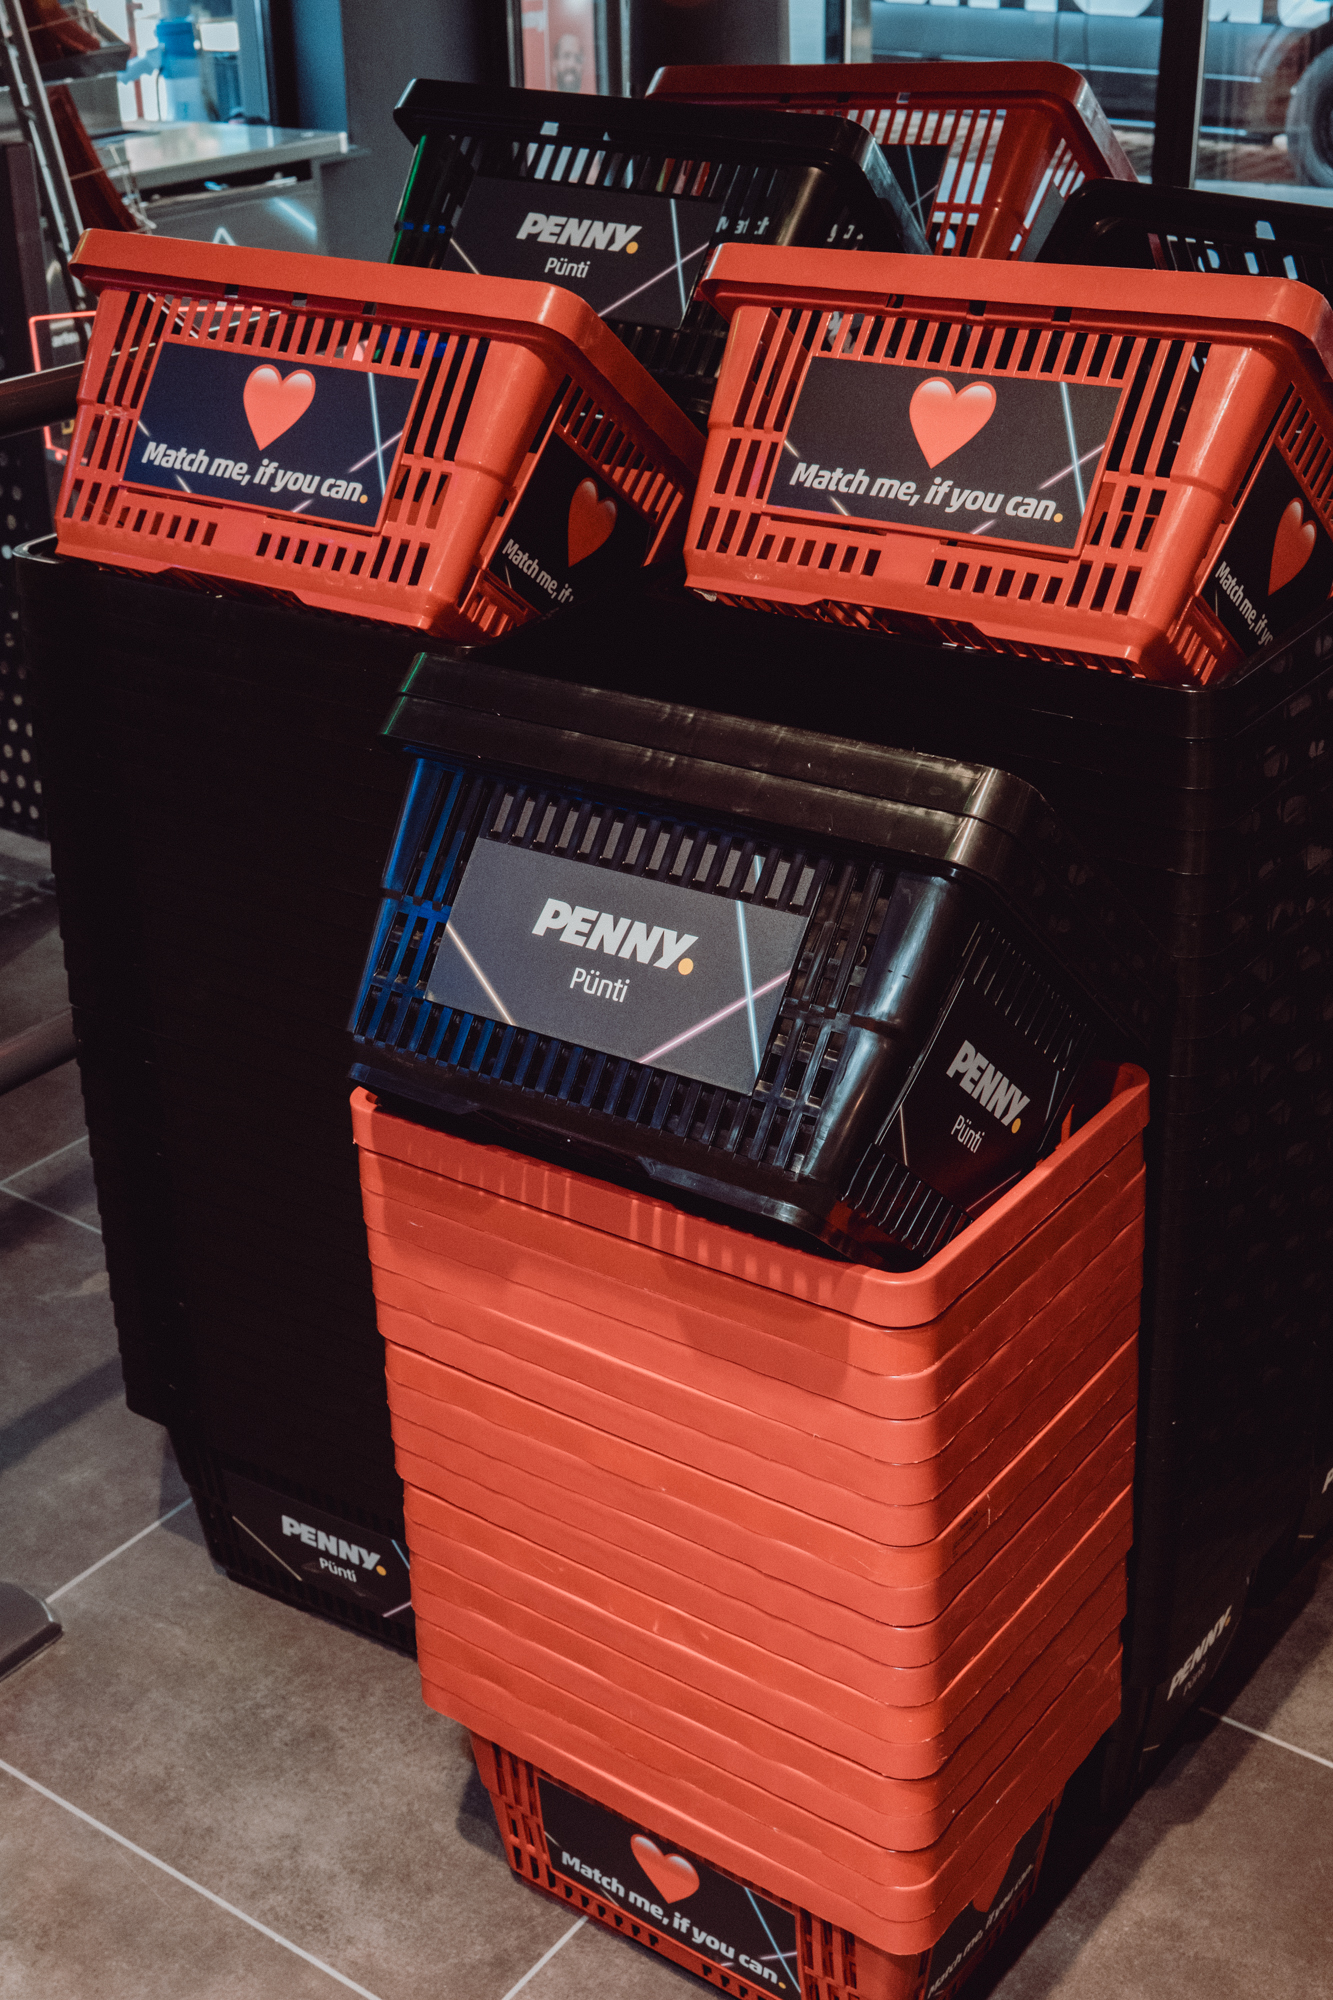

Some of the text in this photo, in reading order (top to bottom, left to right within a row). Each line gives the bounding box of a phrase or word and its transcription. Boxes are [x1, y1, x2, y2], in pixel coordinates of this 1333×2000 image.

[516, 212, 642, 254] PENNY.
[544, 257, 591, 278] Pünti
[141, 441, 368, 504] Match me, if you can.
[789, 462, 1063, 523] Match me, if you can.
[501, 538, 573, 604] Match me, if
[1214, 561, 1244, 607] Match
[1239, 598, 1257, 630] me,
[1254, 613, 1268, 636] if
[531, 898, 699, 976] PENNY.
[569, 967, 630, 1003] Pünti
[946, 1040, 1031, 1134] PENNY.
[951, 1114, 985, 1154] Pünti
[281, 1514, 387, 1576] PENNY.
[319, 1557, 357, 1583] Pünti
[561, 1851, 786, 1989] Match me, if you can.
